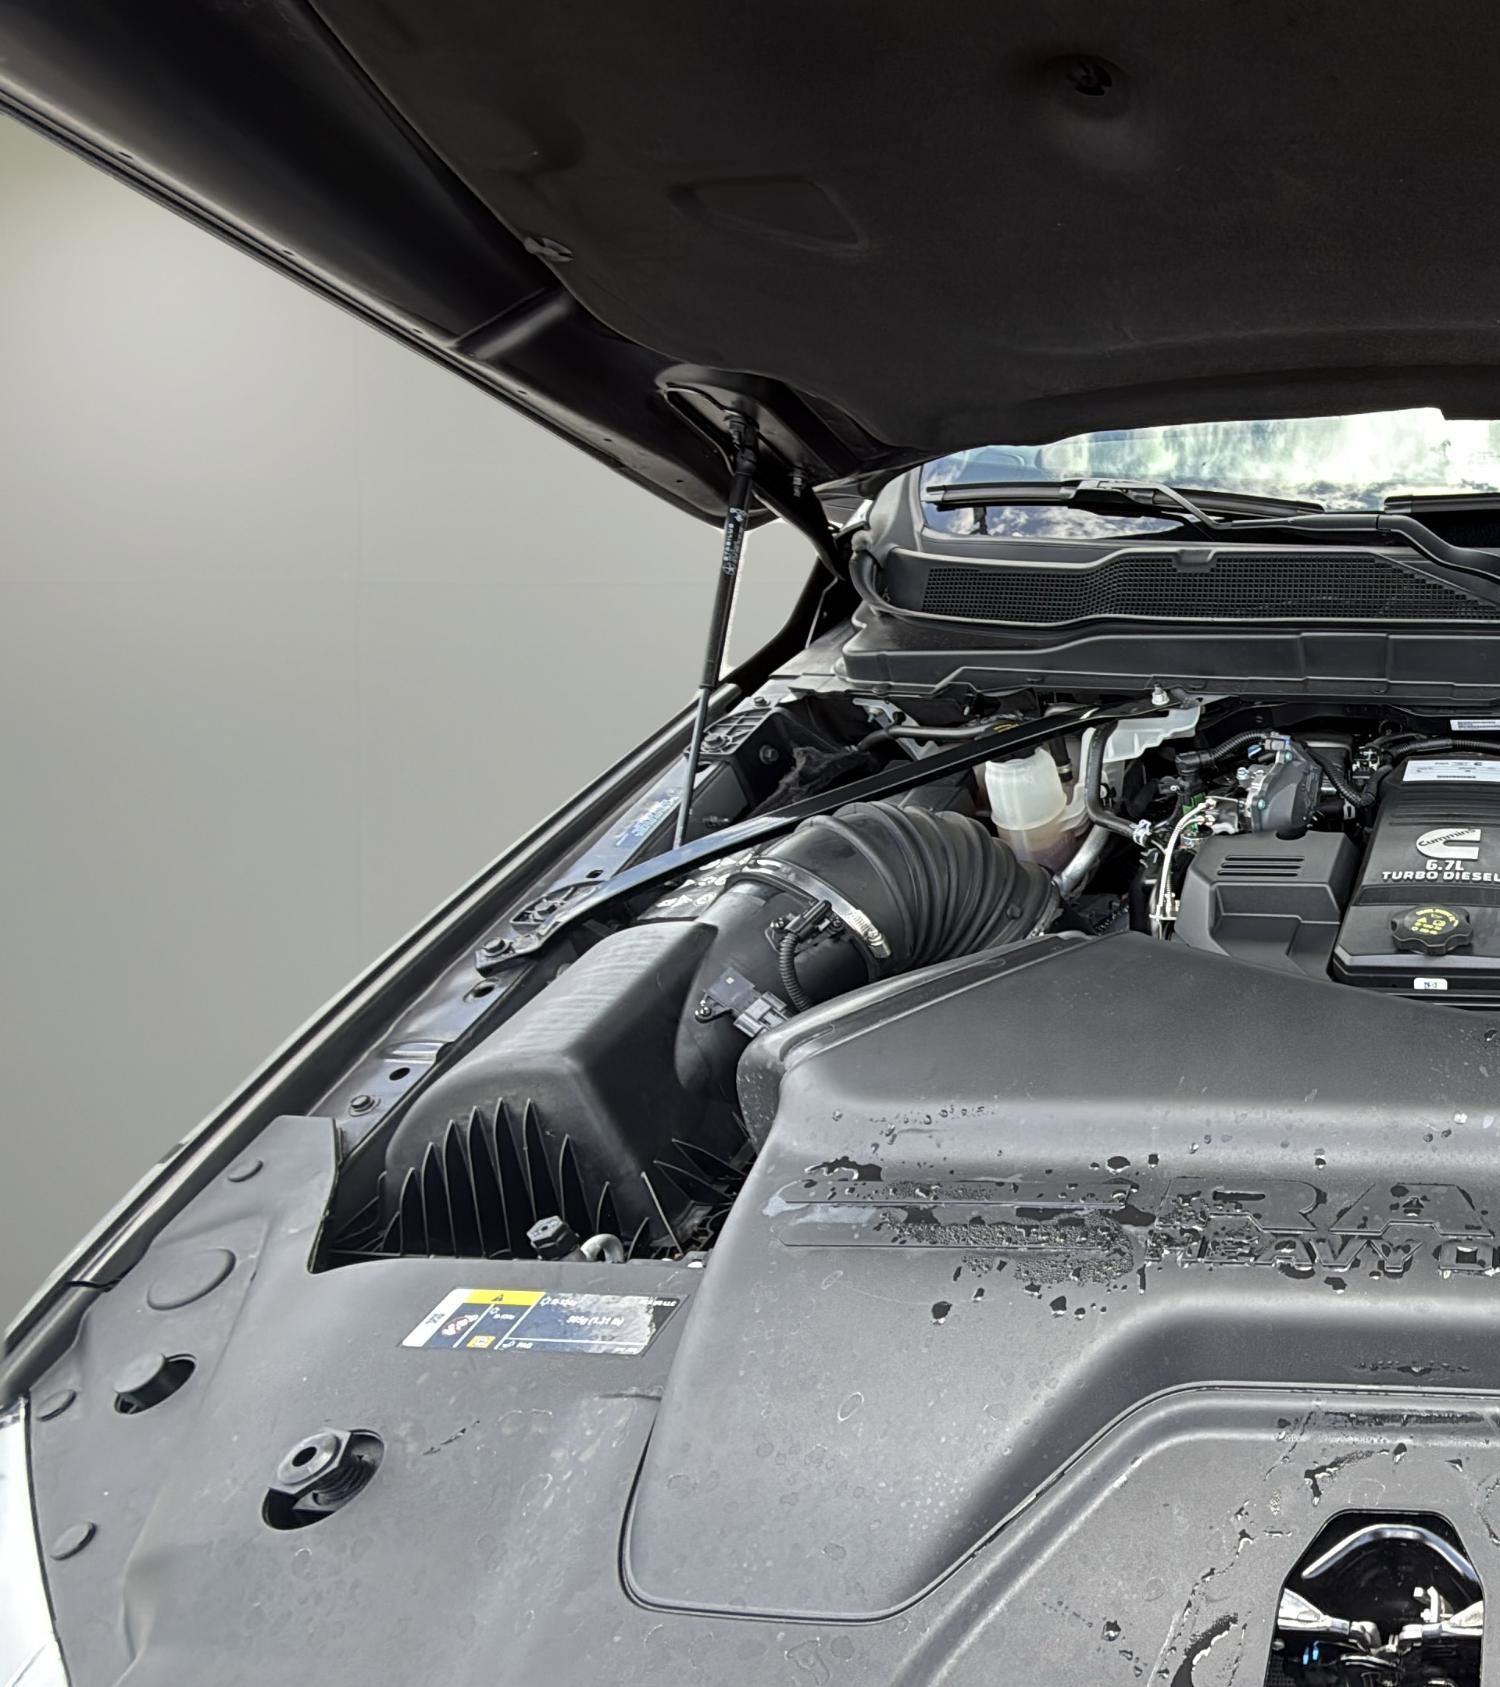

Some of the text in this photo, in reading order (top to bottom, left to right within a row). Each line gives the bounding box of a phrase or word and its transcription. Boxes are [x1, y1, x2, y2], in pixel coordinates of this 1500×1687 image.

[1425, 860, 1464, 871] 6.7L
[1382, 871, 1439, 880] TURBO
[1145, 1225, 1423, 1273] HEAVY
